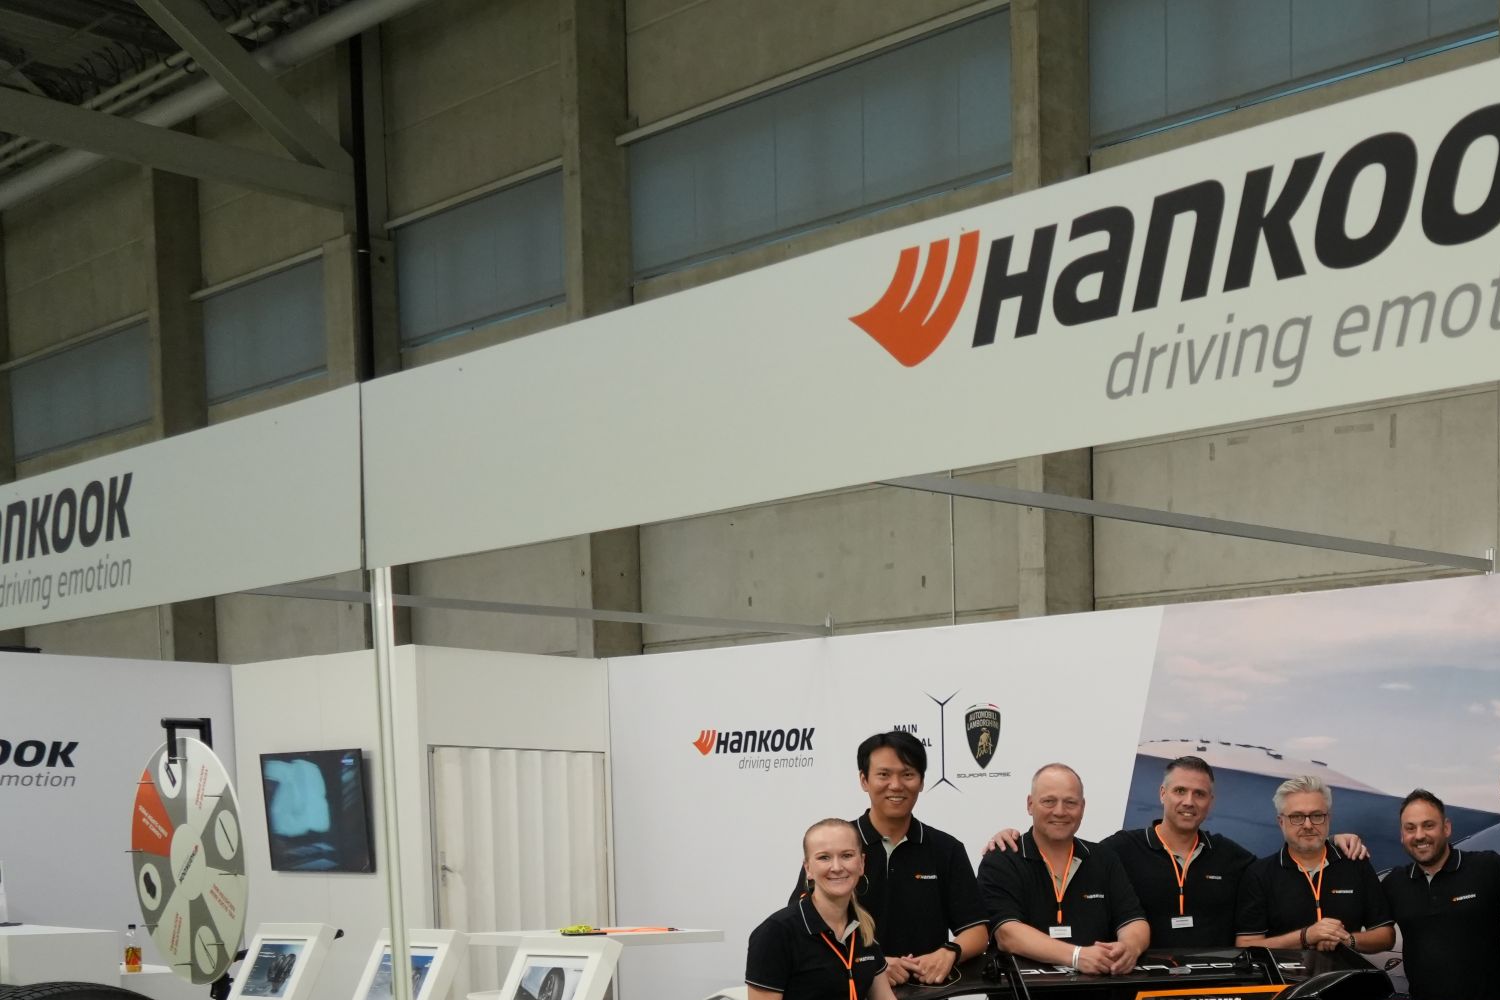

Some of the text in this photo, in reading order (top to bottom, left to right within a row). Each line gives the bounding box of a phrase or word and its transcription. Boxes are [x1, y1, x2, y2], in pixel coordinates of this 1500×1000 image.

[1105, 311, 1313, 400] driving
[0, 472, 133, 565] nKOOK
[57, 554, 132, 598] emotion
[893, 723, 918, 734] MAIN
[738, 754, 814, 772] driving emotion
